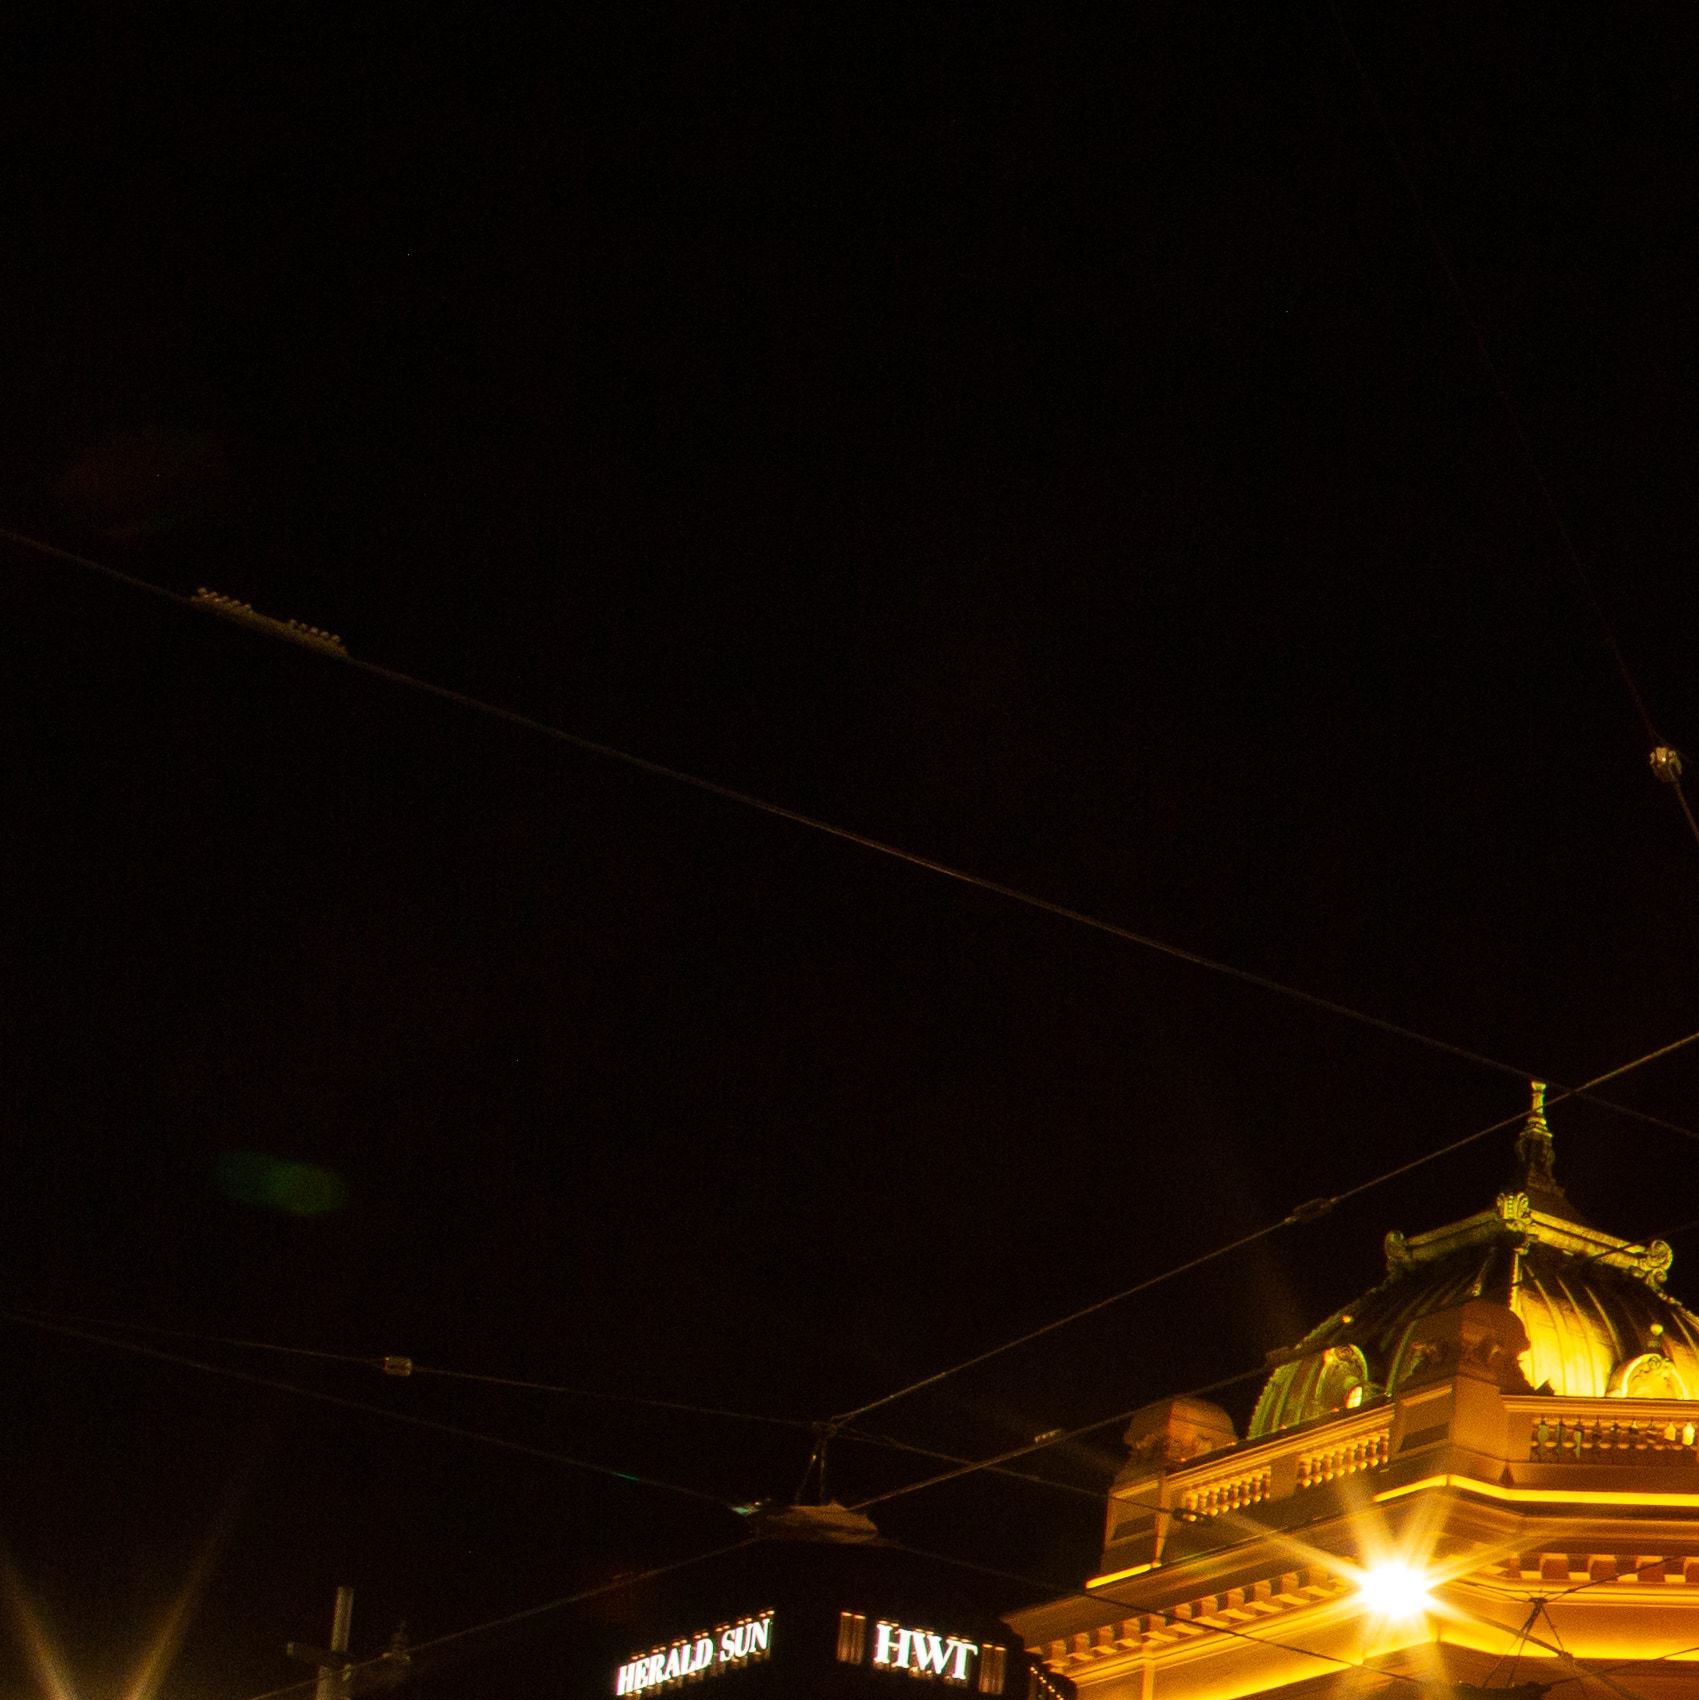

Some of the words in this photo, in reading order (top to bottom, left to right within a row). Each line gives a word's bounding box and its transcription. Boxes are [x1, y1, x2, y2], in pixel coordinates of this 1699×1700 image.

[616, 1638, 713, 1696] HERALD
[719, 1618, 771, 1662] SUN
[874, 1623, 979, 1680] HWT
